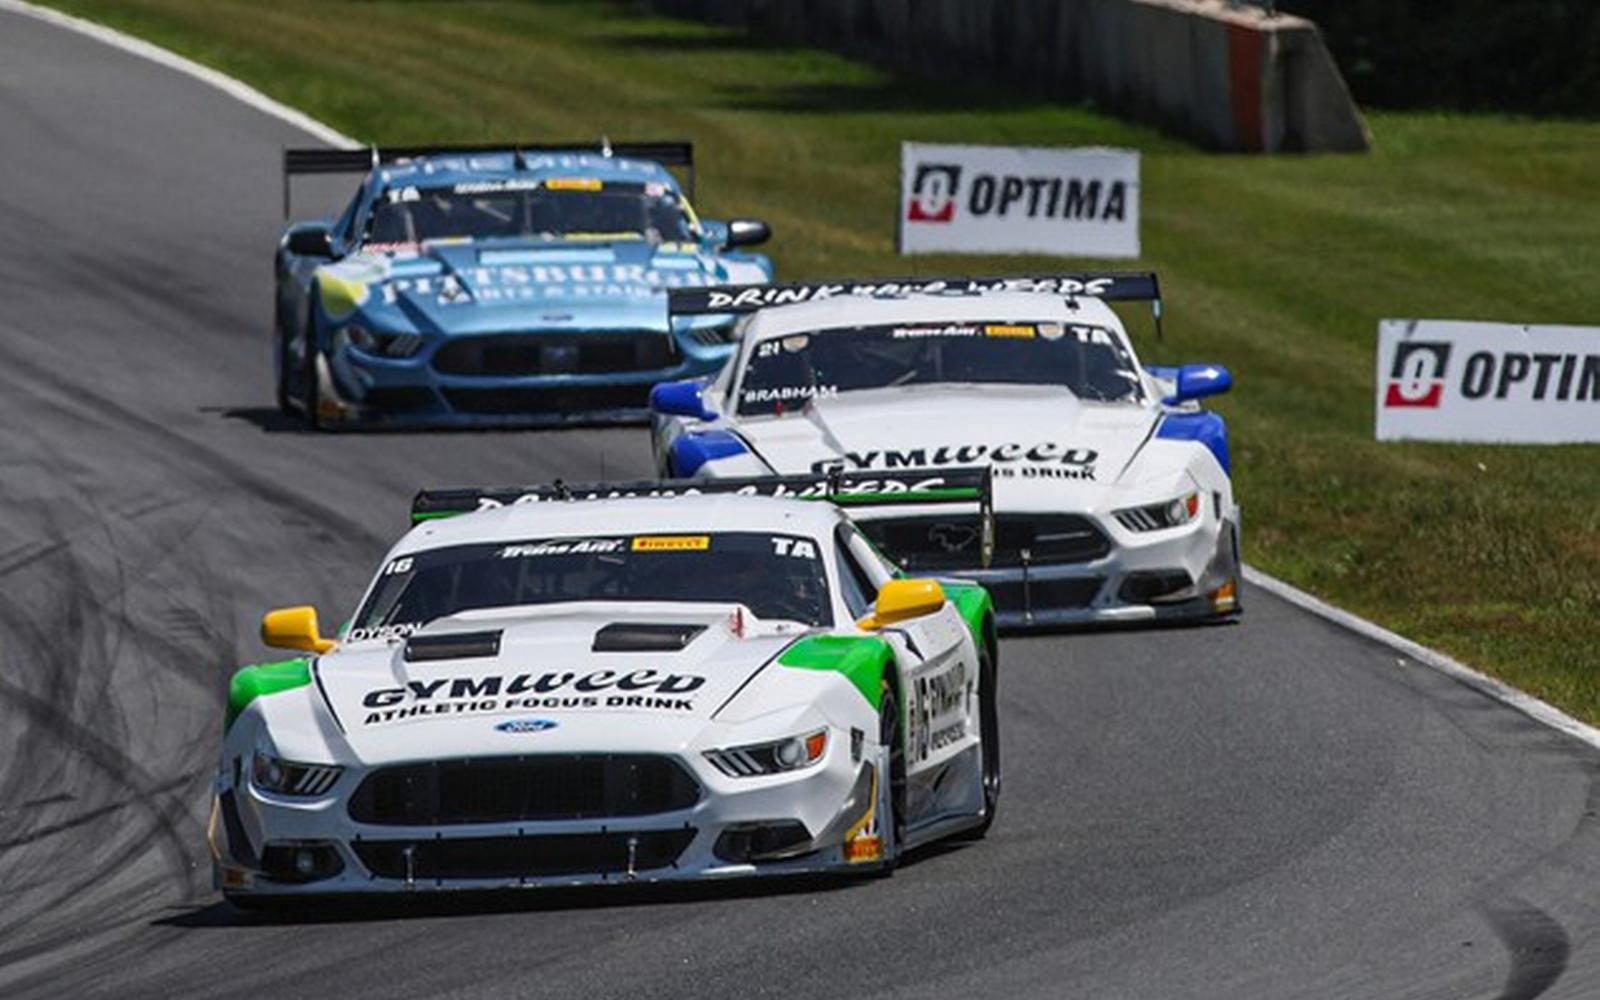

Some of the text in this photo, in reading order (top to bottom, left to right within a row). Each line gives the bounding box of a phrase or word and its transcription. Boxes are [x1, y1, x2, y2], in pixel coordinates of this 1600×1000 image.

[968, 174, 1126, 220] OPTIMA
[1073, 326, 1110, 346] TA
[759, 341, 781, 357] 21
[745, 384, 839, 404] BRABHAM
[1019, 468, 1096, 484] DRINK
[771, 536, 818, 561] TA
[385, 557, 415, 576] 16
[362, 694, 694, 726] ATHLETIC FOCUS DRINK
